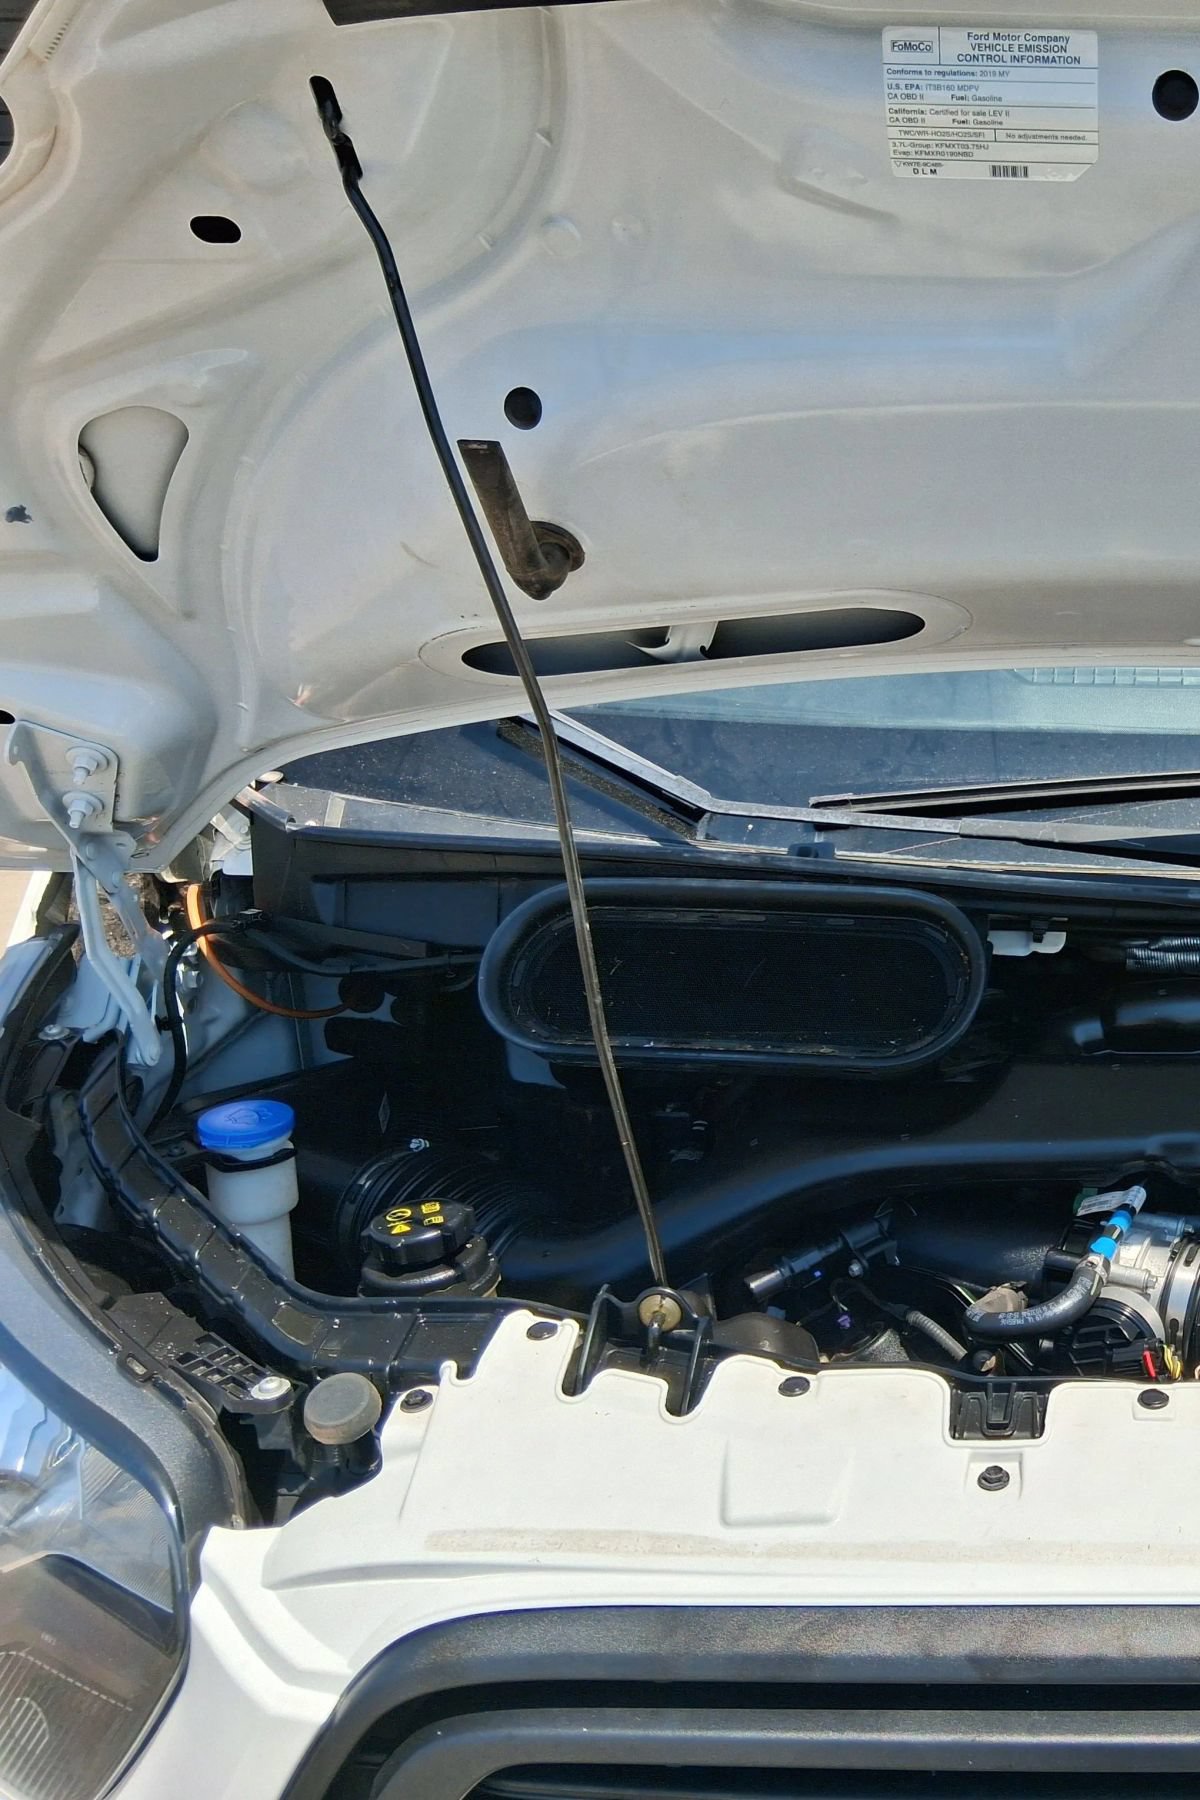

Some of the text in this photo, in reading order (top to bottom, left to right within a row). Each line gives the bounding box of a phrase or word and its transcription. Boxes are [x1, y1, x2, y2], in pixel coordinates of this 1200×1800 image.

[967, 32, 1070, 44] Ford Motor Company
[892, 41, 932, 51] FoMoCo
[971, 43, 1068, 53] VEHICLE EMISSION
[957, 54, 1081, 65] CONTROL INFORMATION
[886, 68, 923, 76] Conforms
[934, 70, 978, 78] regulations:
[971, 94, 1003, 102] Gasoline
[888, 107, 927, 115] California:
[929, 108, 959, 116] Certified
